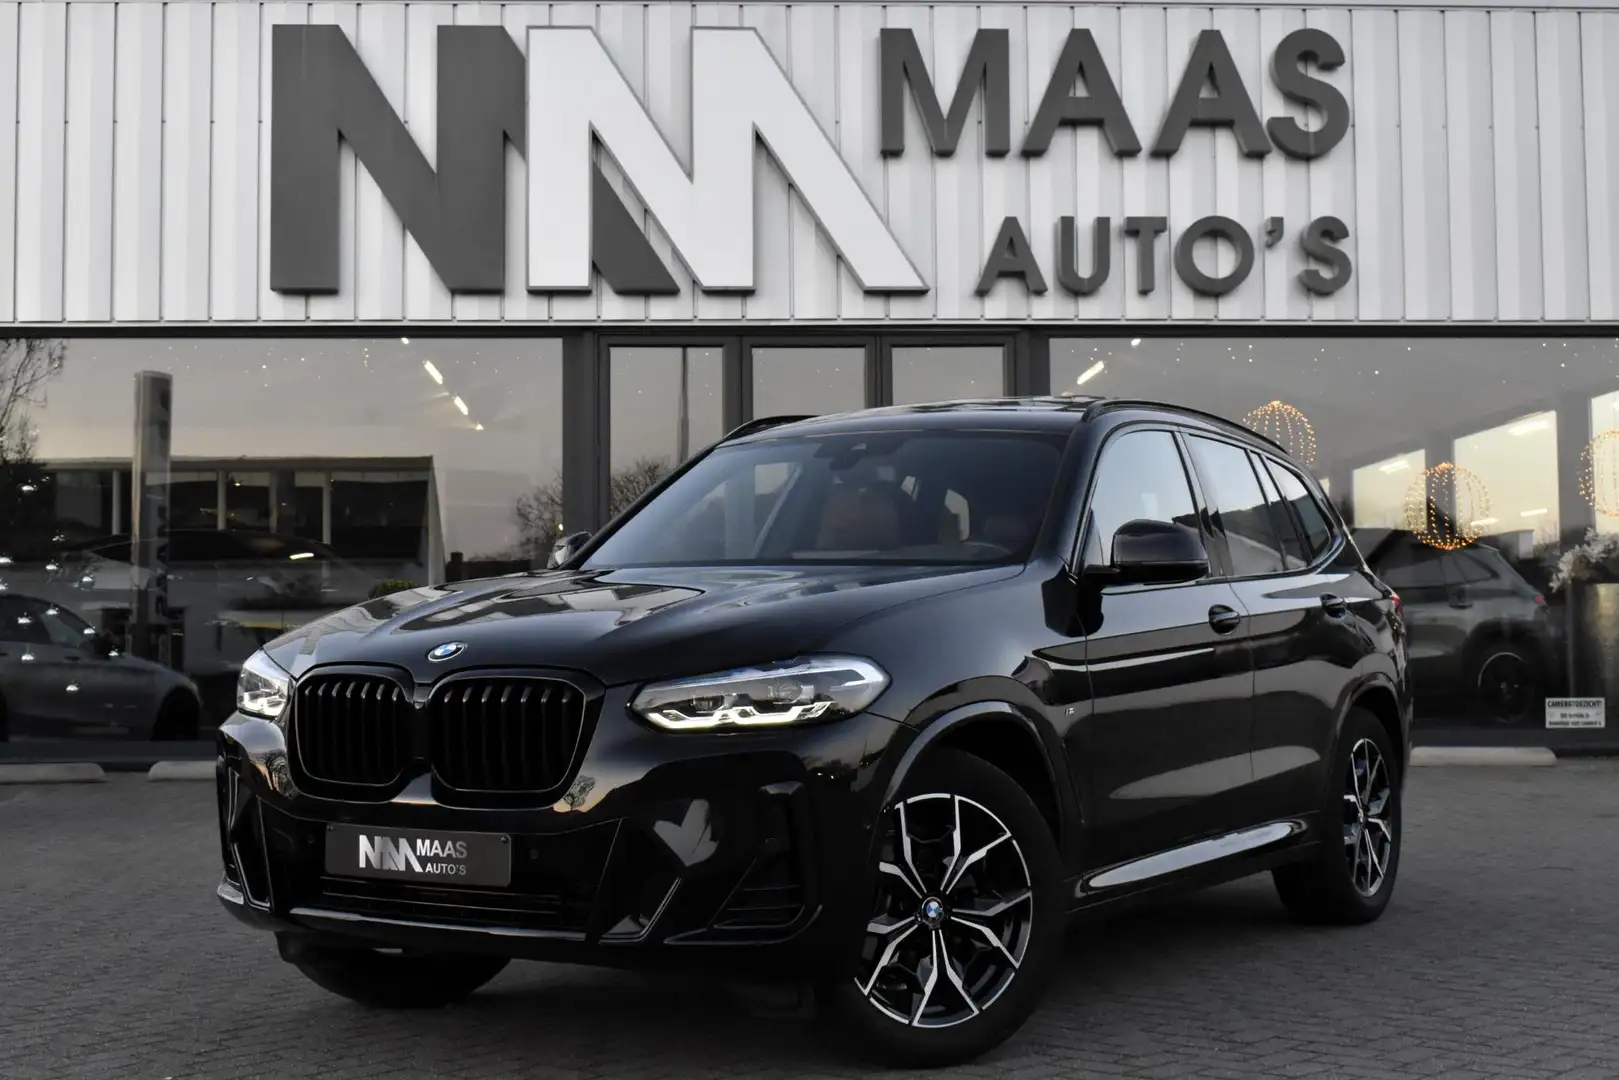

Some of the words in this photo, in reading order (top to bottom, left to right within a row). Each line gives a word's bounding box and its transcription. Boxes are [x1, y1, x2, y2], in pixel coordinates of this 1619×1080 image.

[880, 28, 1350, 160] MAAS
[975, 215, 1352, 297] AUTO'S
[416, 838, 468, 859] MAAS
[425, 862, 467, 876] AUTO'S
